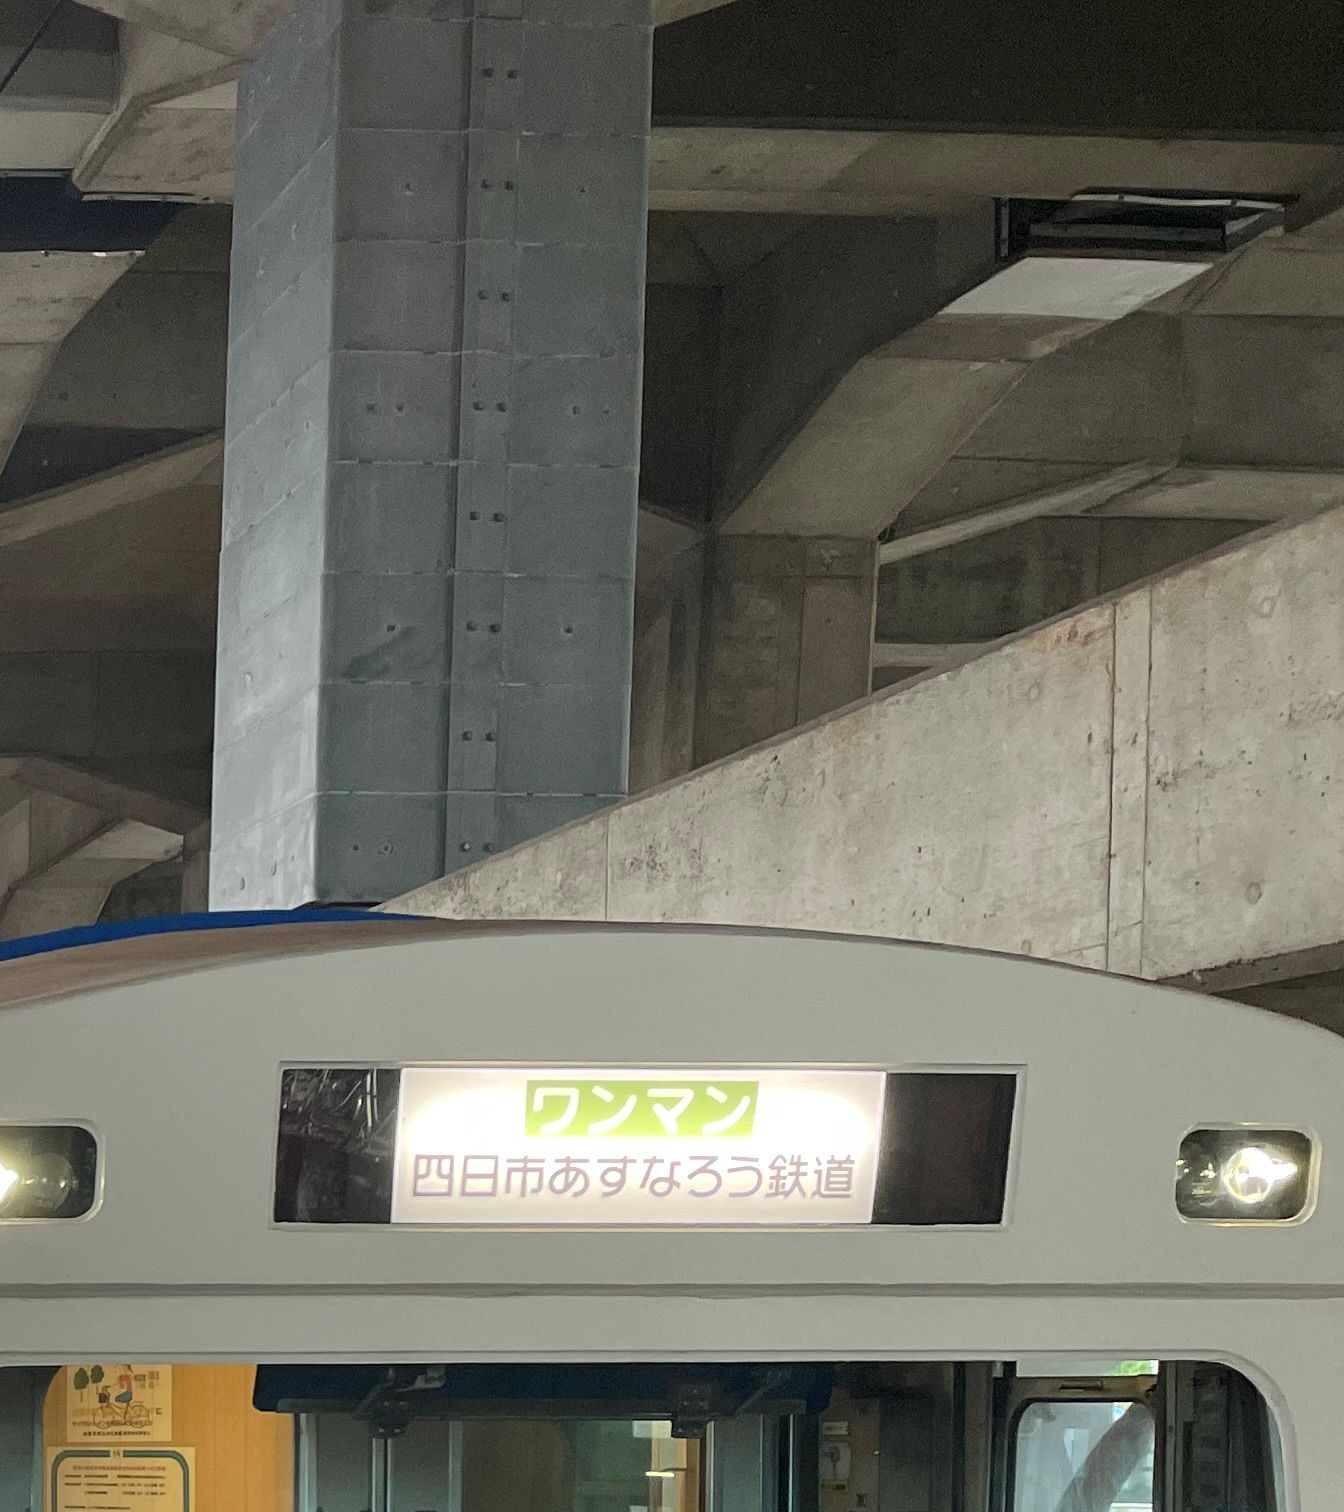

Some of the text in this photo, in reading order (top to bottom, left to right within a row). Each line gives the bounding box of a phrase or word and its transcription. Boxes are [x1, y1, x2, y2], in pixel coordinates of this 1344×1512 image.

[532, 1086, 752, 1134] ワンマン
[412, 1154, 856, 1200] 四日市あすなろう鉄道
